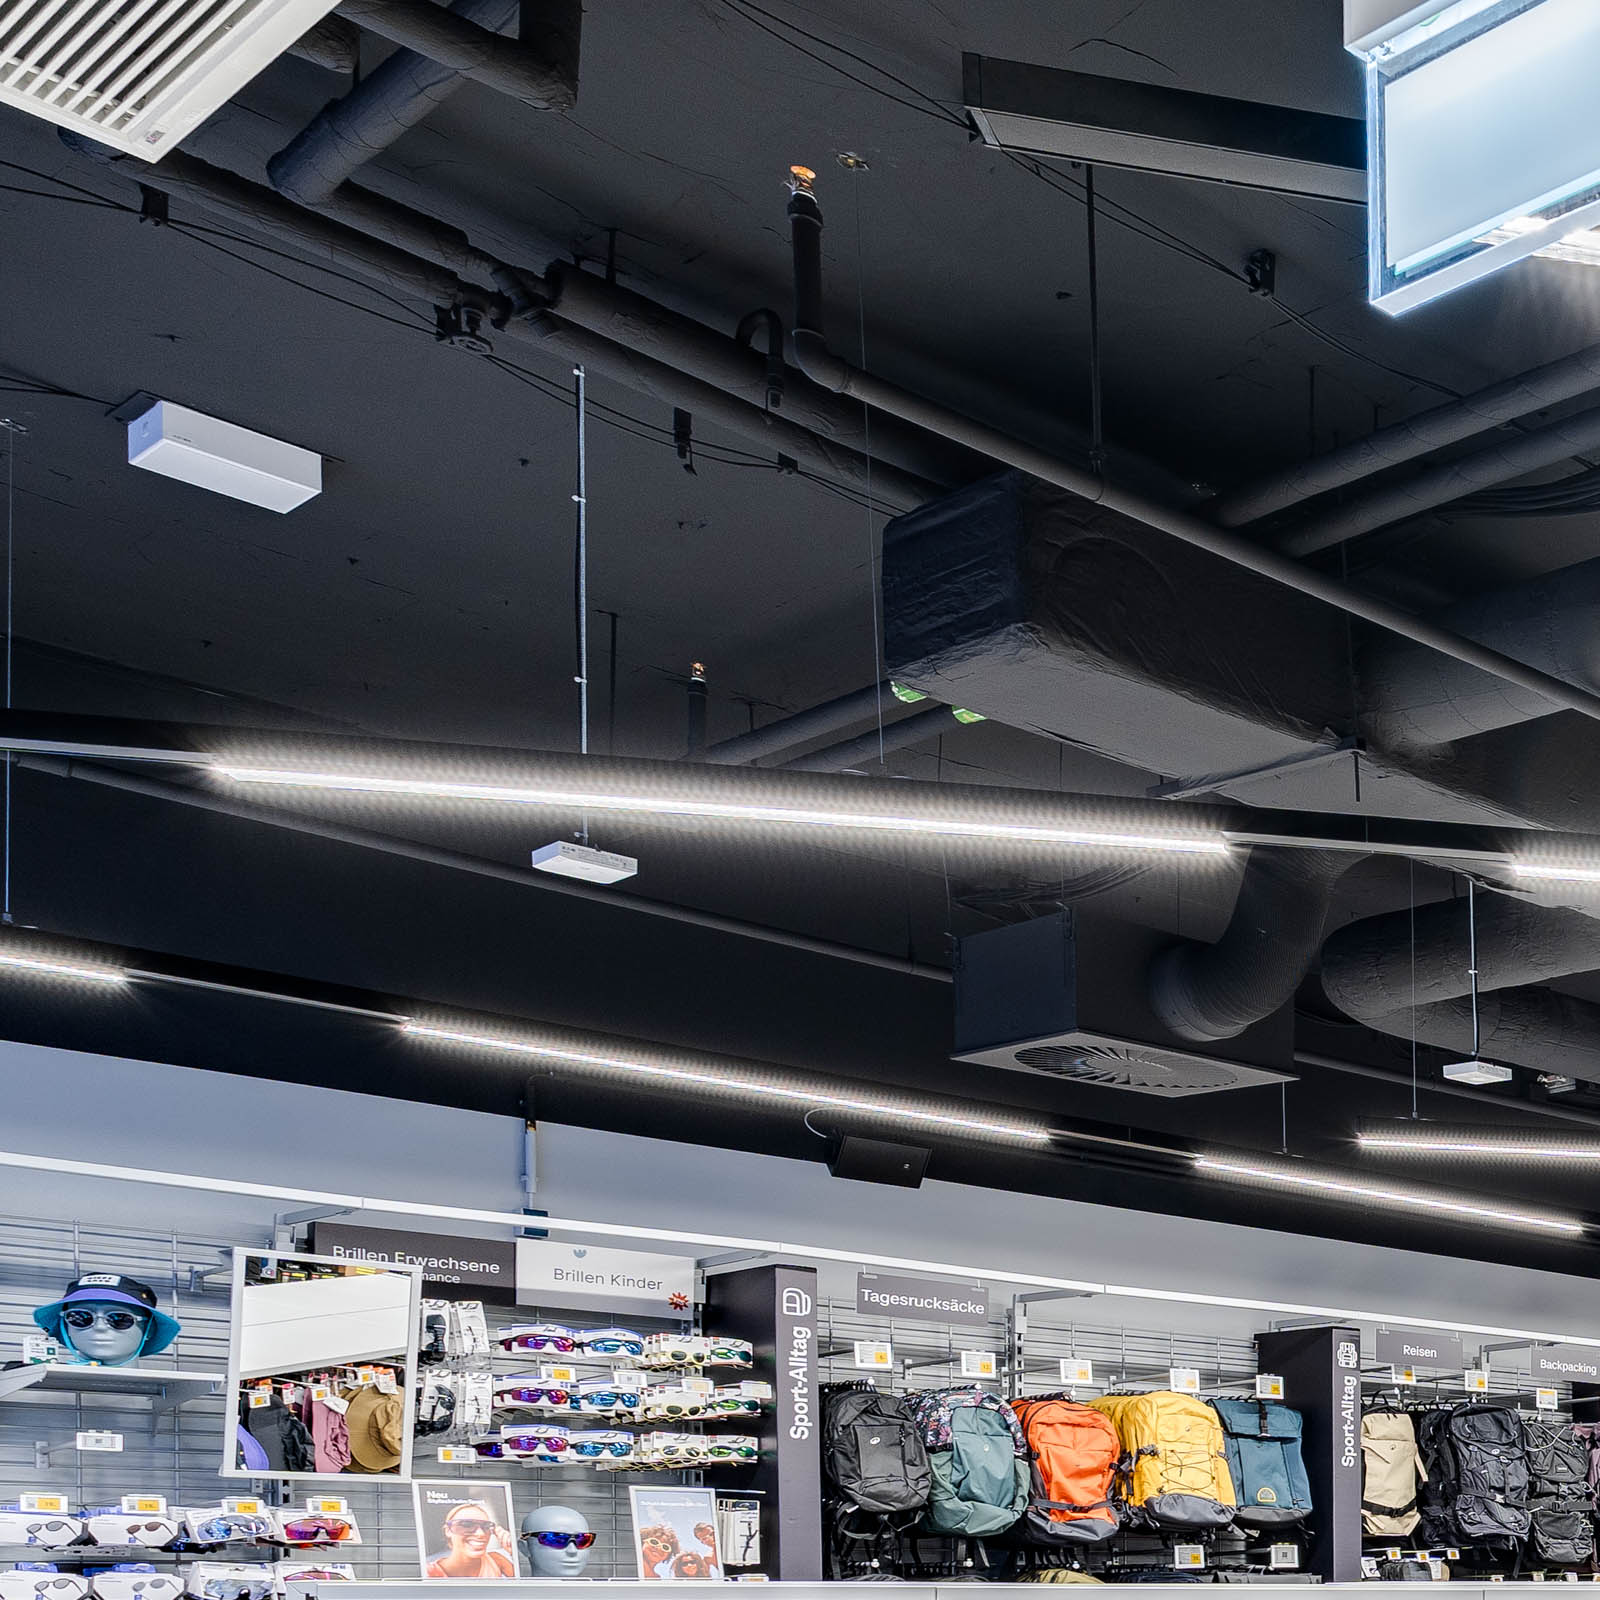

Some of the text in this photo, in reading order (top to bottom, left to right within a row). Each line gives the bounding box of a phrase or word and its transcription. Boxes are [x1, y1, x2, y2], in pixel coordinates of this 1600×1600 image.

[332, 1245, 500, 1274] Brillen Erwachsene
[554, 1268, 663, 1291] Brillen Kinder
[862, 1288, 986, 1316] Tagesrucksäcke
[1402, 1344, 1437, 1358] Reisen
[1540, 1359, 1597, 1376] Backpacking
[789, 1326, 812, 1440] Sport-Alltag
[1341, 1375, 1357, 1468] Sport-Alltag
[426, 1490, 448, 1498] Neu
